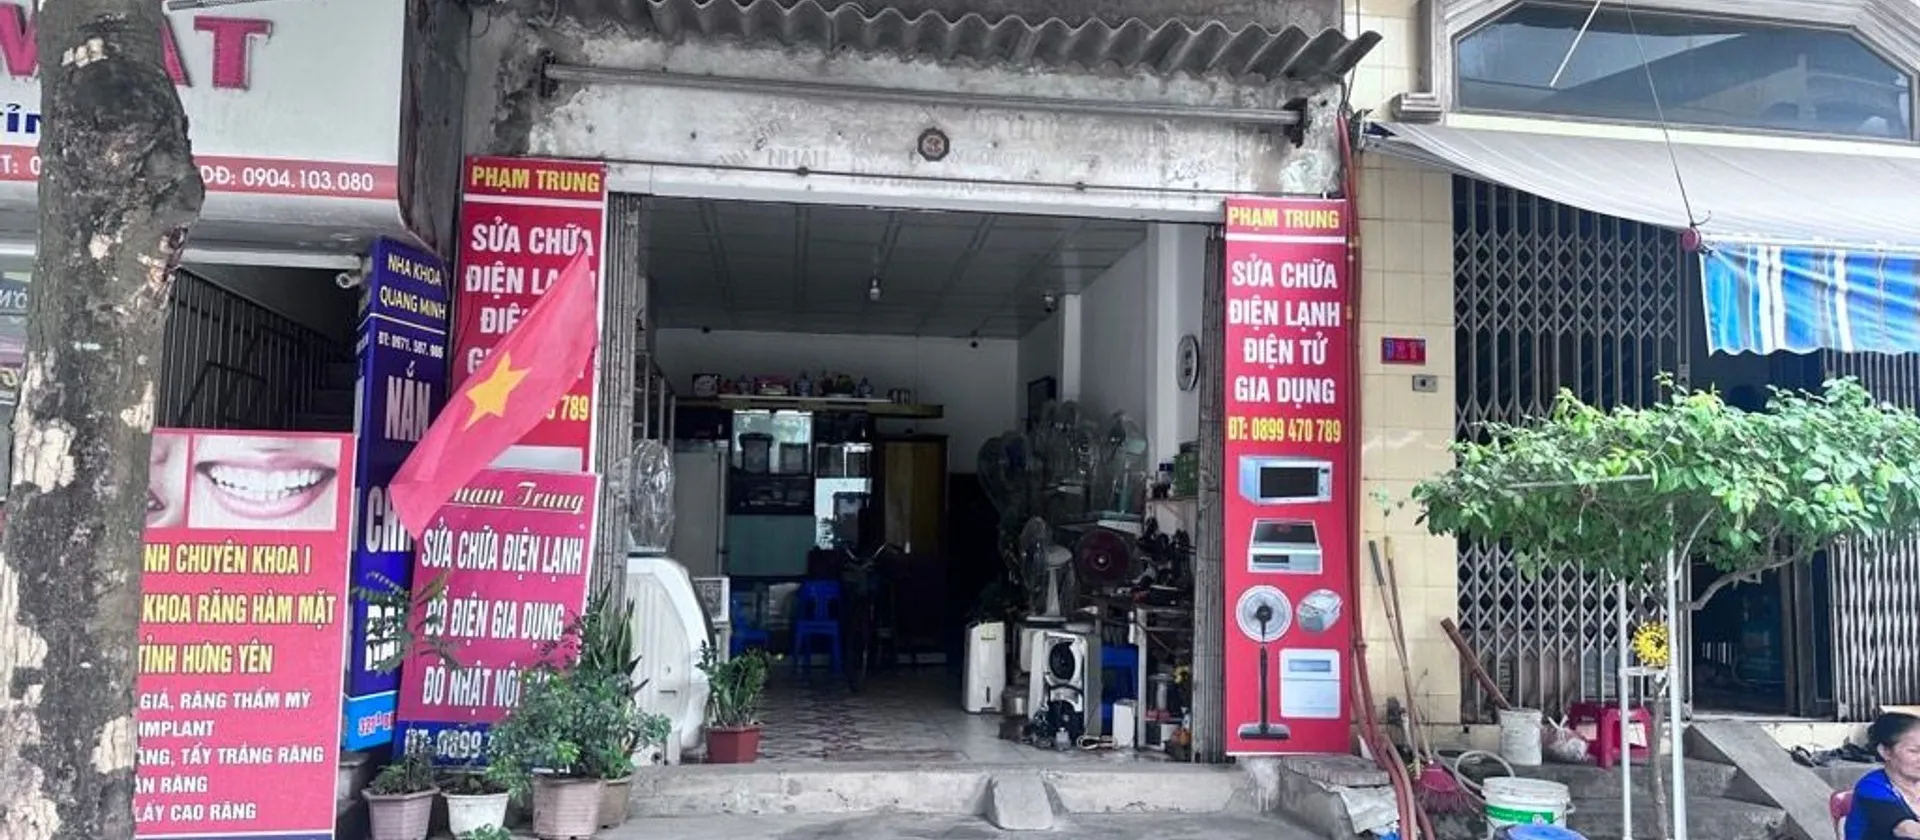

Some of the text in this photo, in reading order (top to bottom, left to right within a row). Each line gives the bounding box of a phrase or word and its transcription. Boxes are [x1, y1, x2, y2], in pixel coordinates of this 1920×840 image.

[242, 167, 374, 192] 0904.103.080
[471, 165, 600, 193] PHẠM TRUNG
[471, 215, 521, 253] SỬA
[1228, 206, 1340, 231] PHẠM TRUNG
[388, 252, 442, 287] NHA KHOA
[465, 260, 524, 299] ĐIỆN
[1231, 252, 1338, 289] SỬA CHỮA
[379, 285, 446, 320] QUANG MINH
[1229, 295, 1340, 332] ĐIỆN LẠNH
[1243, 331, 1328, 370] ĐIỆN TỬ
[561, 395, 589, 421] 789
[1234, 376, 1335, 409] GIA DỤNG
[1252, 416, 1285, 442] 0899
[1288, 418, 1313, 442] 470
[1316, 418, 1341, 443] 789
[517, 481, 584, 515] Trung
[144, 538, 311, 574] NH CHUYÊN KHOA I
[422, 516, 584, 582] SỬA CHỮA ĐIỆN LẠNH
[142, 588, 336, 630] KHOA RĂNG HÀM MẶT
[450, 591, 489, 646] ĐIỆN
[491, 600, 517, 639] GIA
[521, 602, 565, 650] DỤNG
[182, 641, 232, 674] HƯNG
[239, 638, 273, 673] YÊN
[180, 689, 227, 710] RĂNG
[448, 659, 492, 716] NHẬT
[138, 720, 215, 738] IMPLANT
[278, 743, 324, 763] RĂNG
[160, 773, 208, 793] RĂNG
[170, 804, 204, 822] CAO
[210, 800, 257, 820] RĂNG
